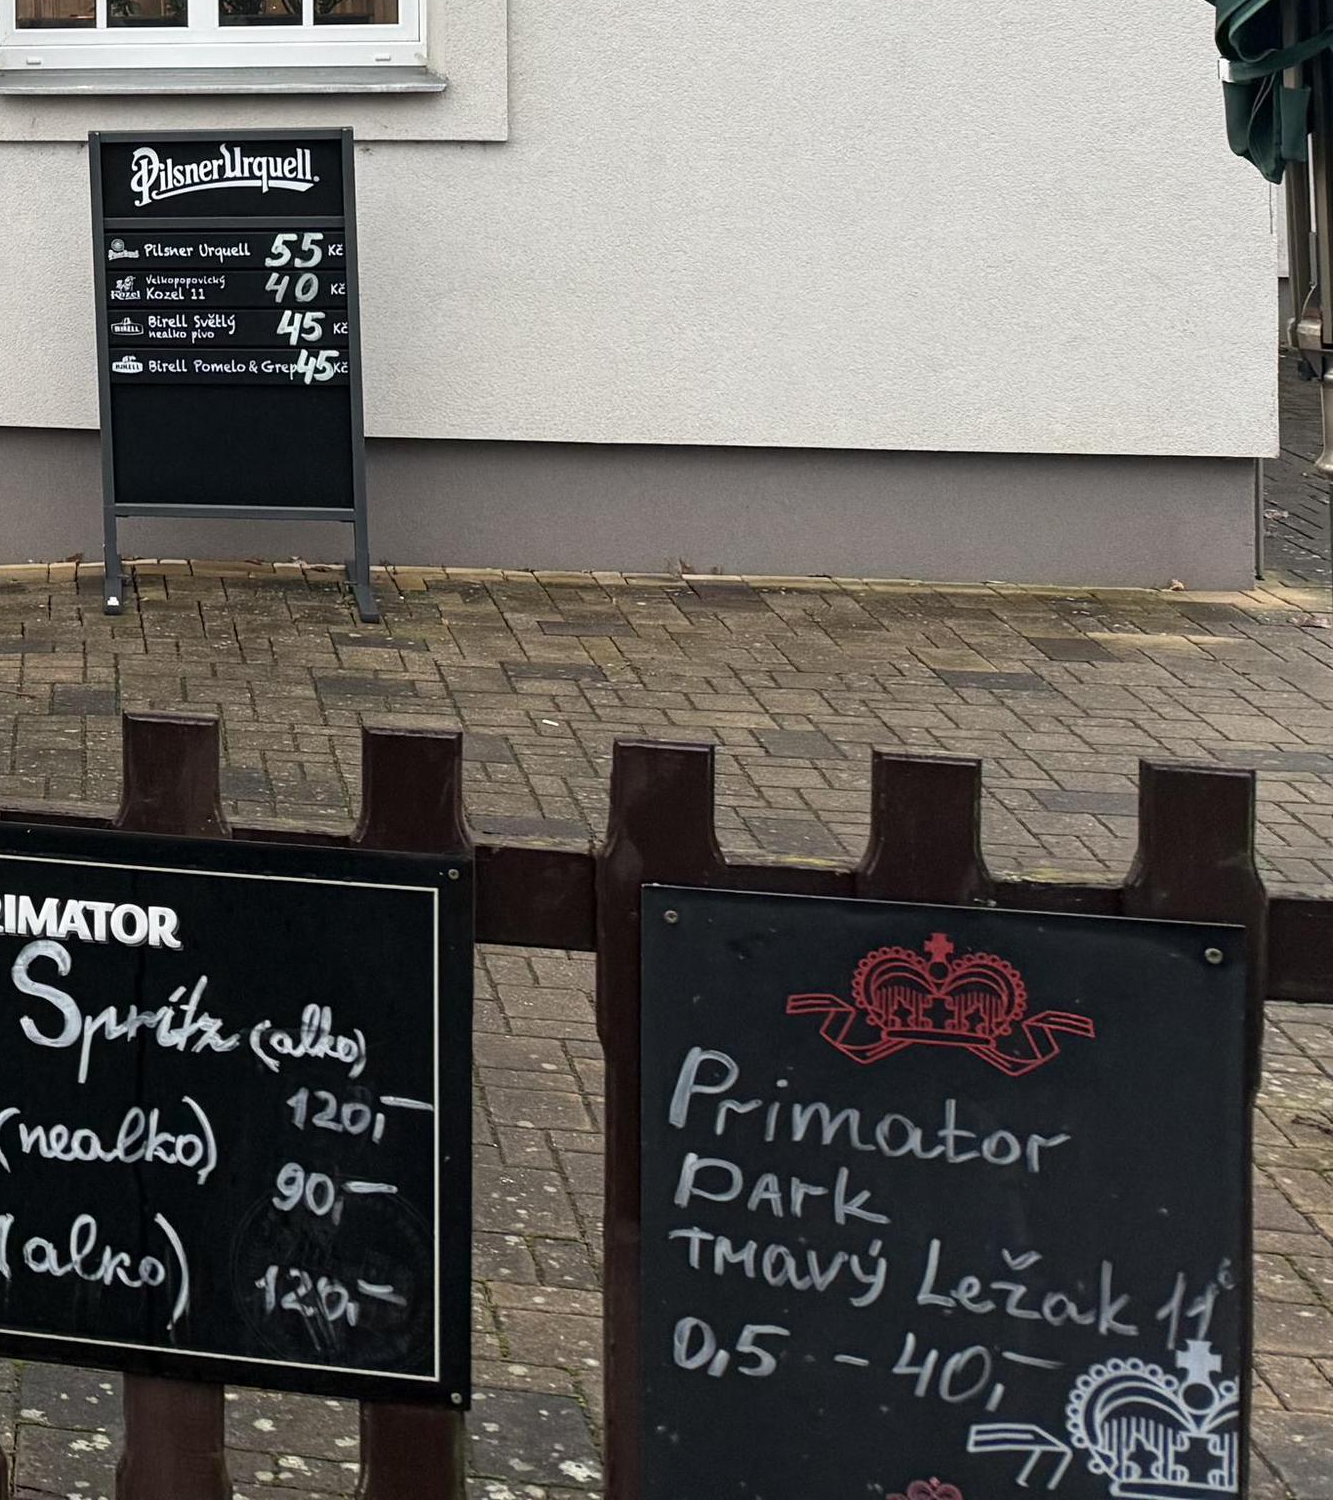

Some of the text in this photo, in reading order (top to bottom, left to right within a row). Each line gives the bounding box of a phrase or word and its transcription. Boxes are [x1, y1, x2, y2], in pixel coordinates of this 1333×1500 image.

[130, 146, 223, 207] Pilsner
[144, 243, 193, 257] Pilsner
[199, 243, 251, 263] Urquell
[265, 232, 324, 268] 55
[328, 244, 344, 256] Kč
[146, 272, 346, 303] Velkopopovický 40 Kč
[146, 287, 206, 300] Kozel 11
[148, 310, 349, 346] Birell Světlý 45 Kč
[148, 328, 215, 344] nealko pivo
[148, 360, 188, 372] Birell
[193, 360, 246, 373] Pomelo
[249, 360, 258, 373] &
[296, 349, 340, 385] 45
[333, 362, 349, 374] Kč
[250, 1003, 367, 1079] (alko)
[669, 1046, 1071, 1173] Primator
[672, 1315, 791, 1378] 0,5
